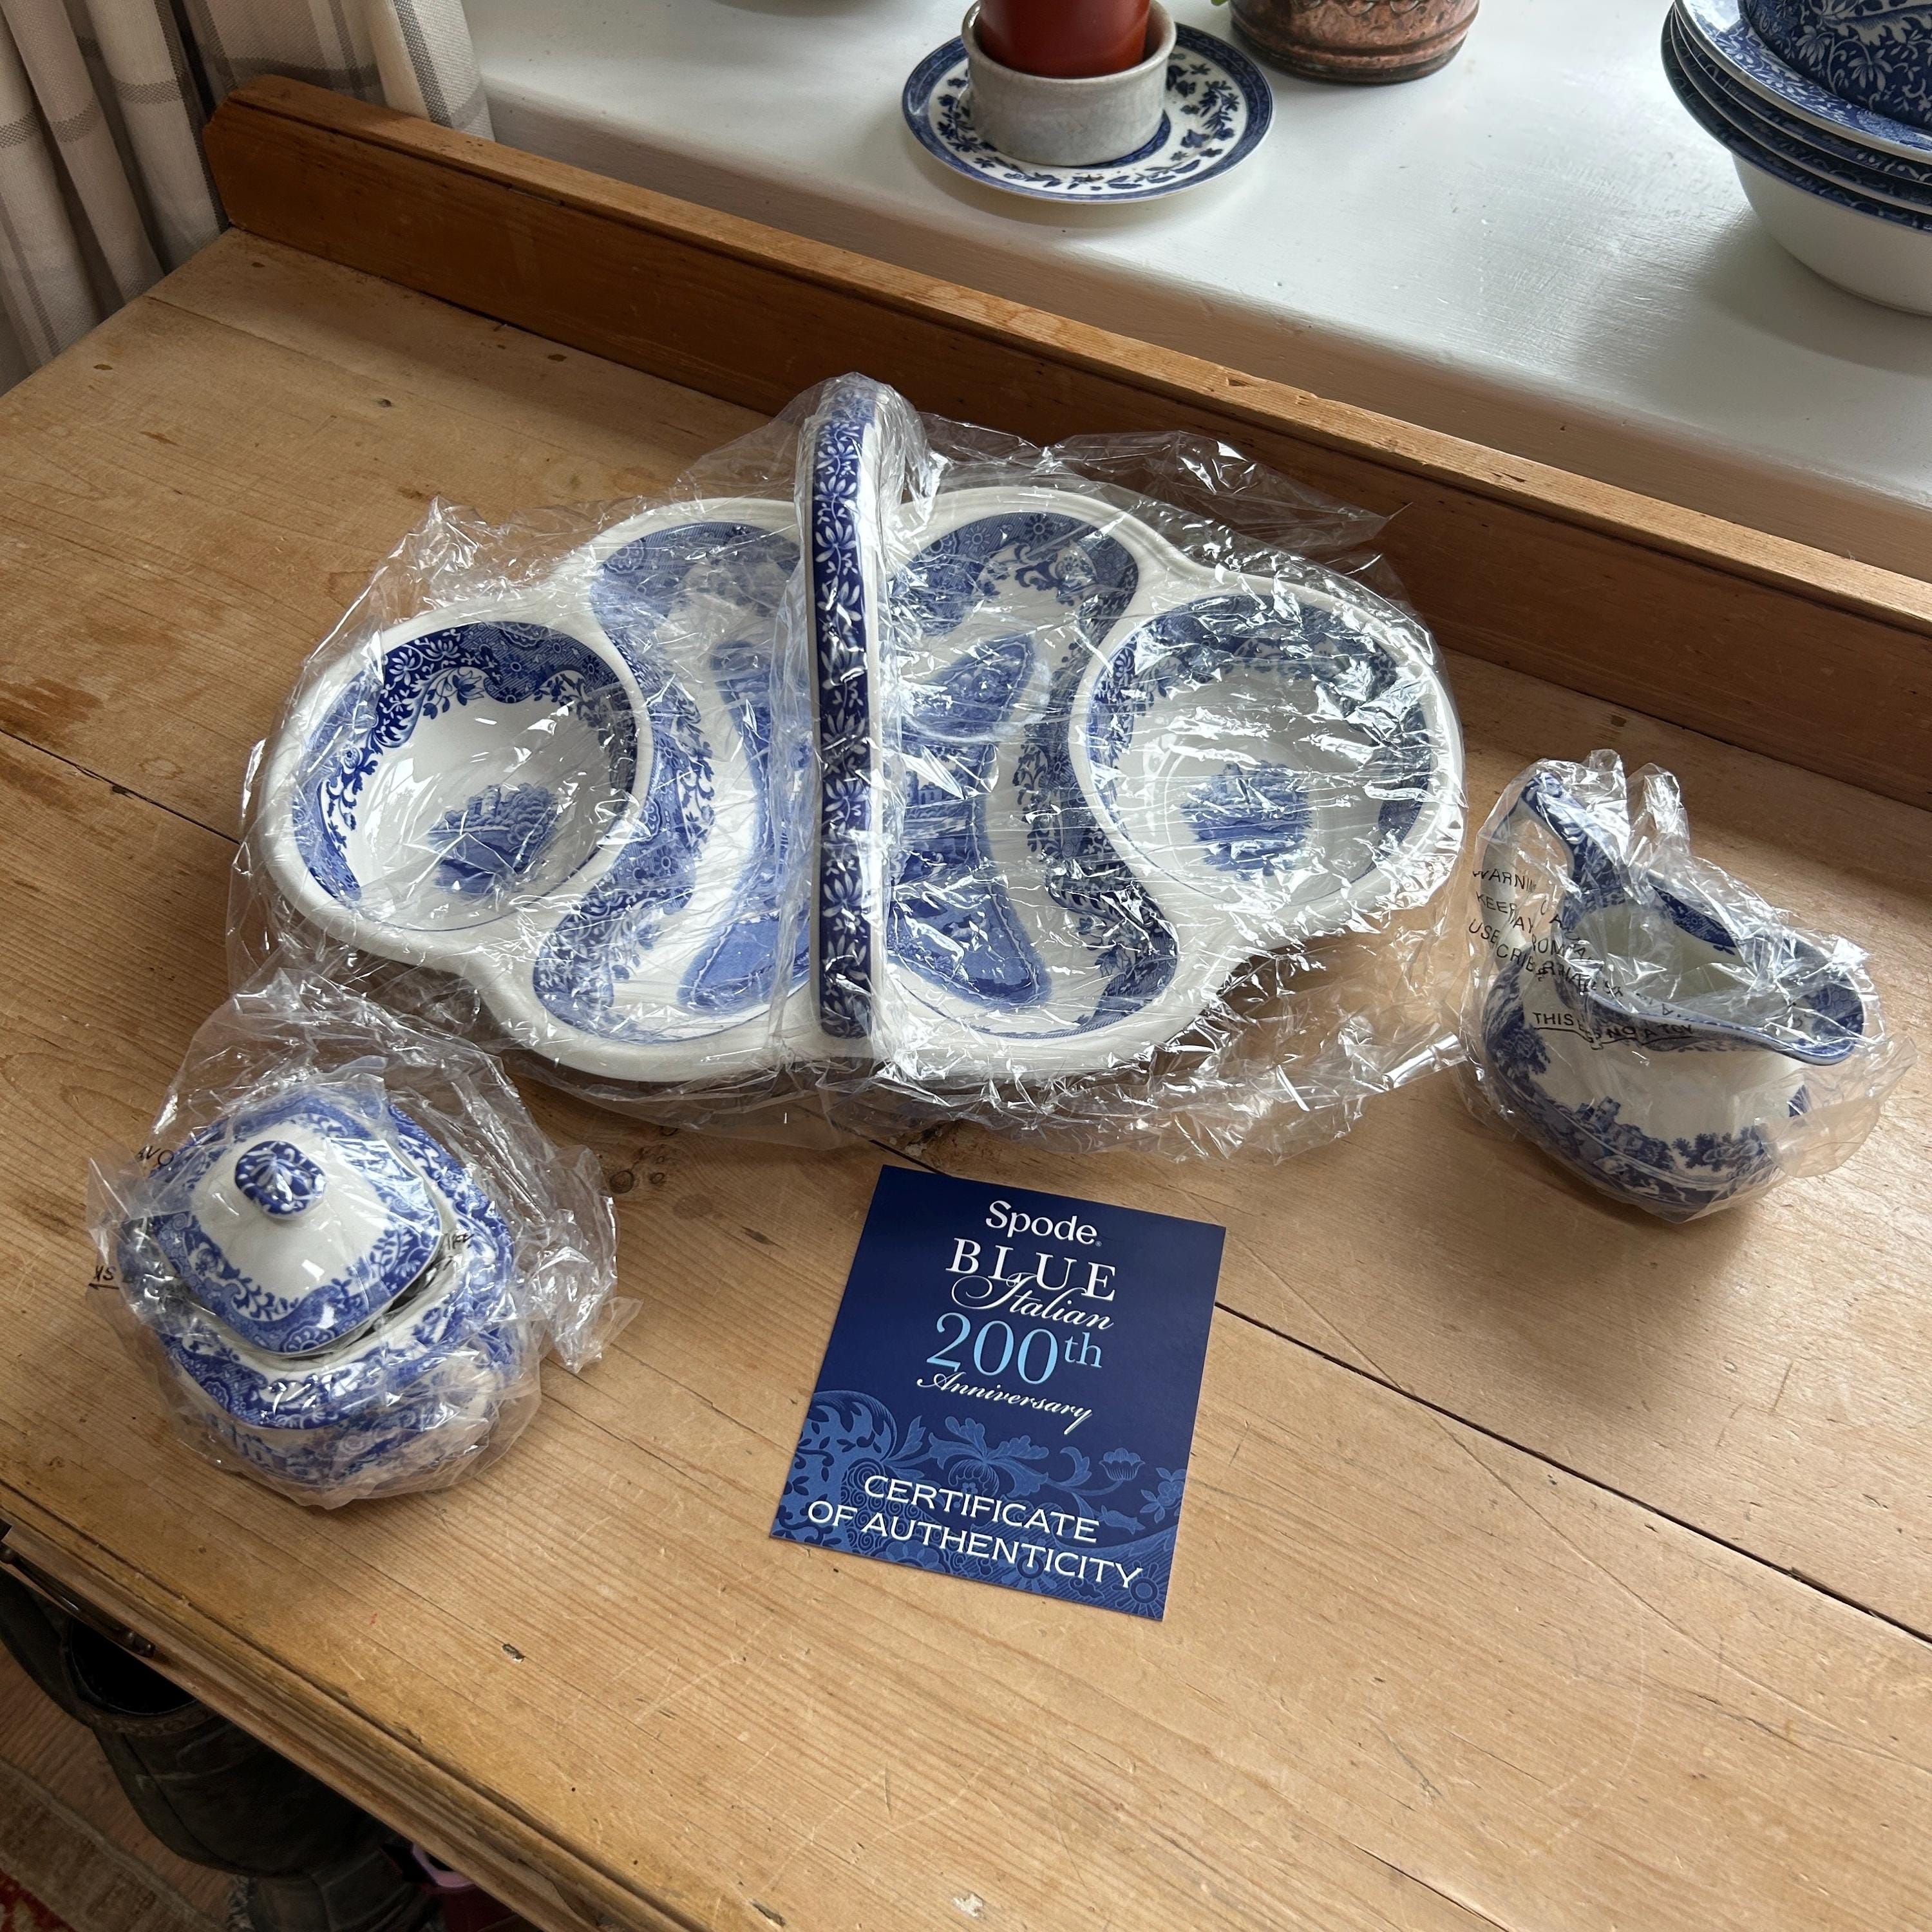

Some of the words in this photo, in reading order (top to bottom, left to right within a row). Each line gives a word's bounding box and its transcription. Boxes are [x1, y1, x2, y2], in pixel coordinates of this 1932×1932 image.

[1468, 918, 1501, 944] USE
[1531, 1012, 1575, 1027] THIS
[945, 1237, 1116, 1302] BLUE
[951, 1272, 1114, 1330] Italian
[926, 1312, 1103, 1385] 200th
[916, 1371, 1094, 1435] Anniversary
[864, 1475, 1100, 1543] CERTIFICATE
[808, 1501, 858, 1527] OF
[861, 1512, 1143, 1589] AUTHENTICITY
